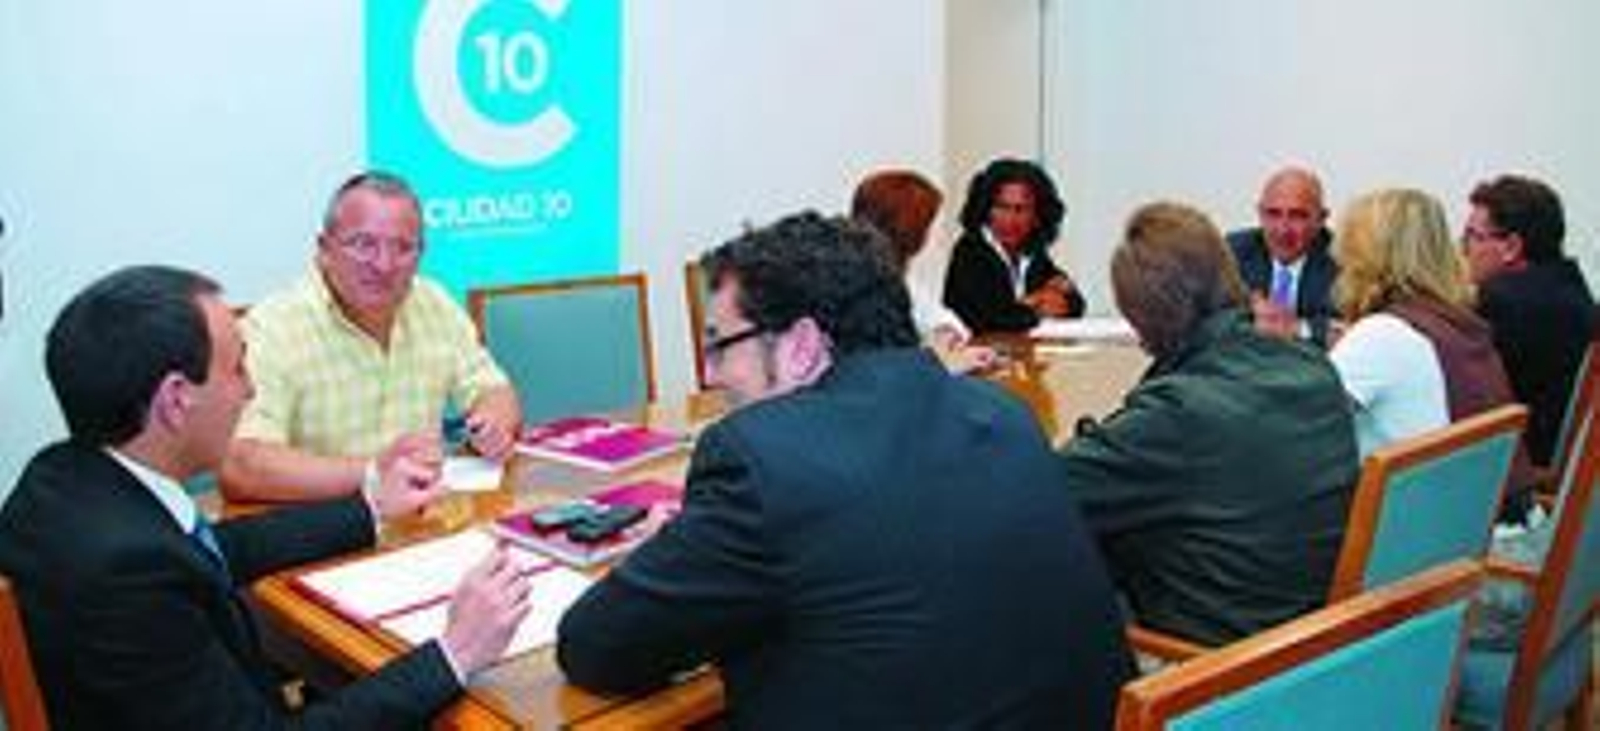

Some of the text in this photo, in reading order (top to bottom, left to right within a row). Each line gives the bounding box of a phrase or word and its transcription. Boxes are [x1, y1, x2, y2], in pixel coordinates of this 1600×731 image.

[475, 31, 549, 94] 10
[423, 188, 573, 229] CIUDAD 10
